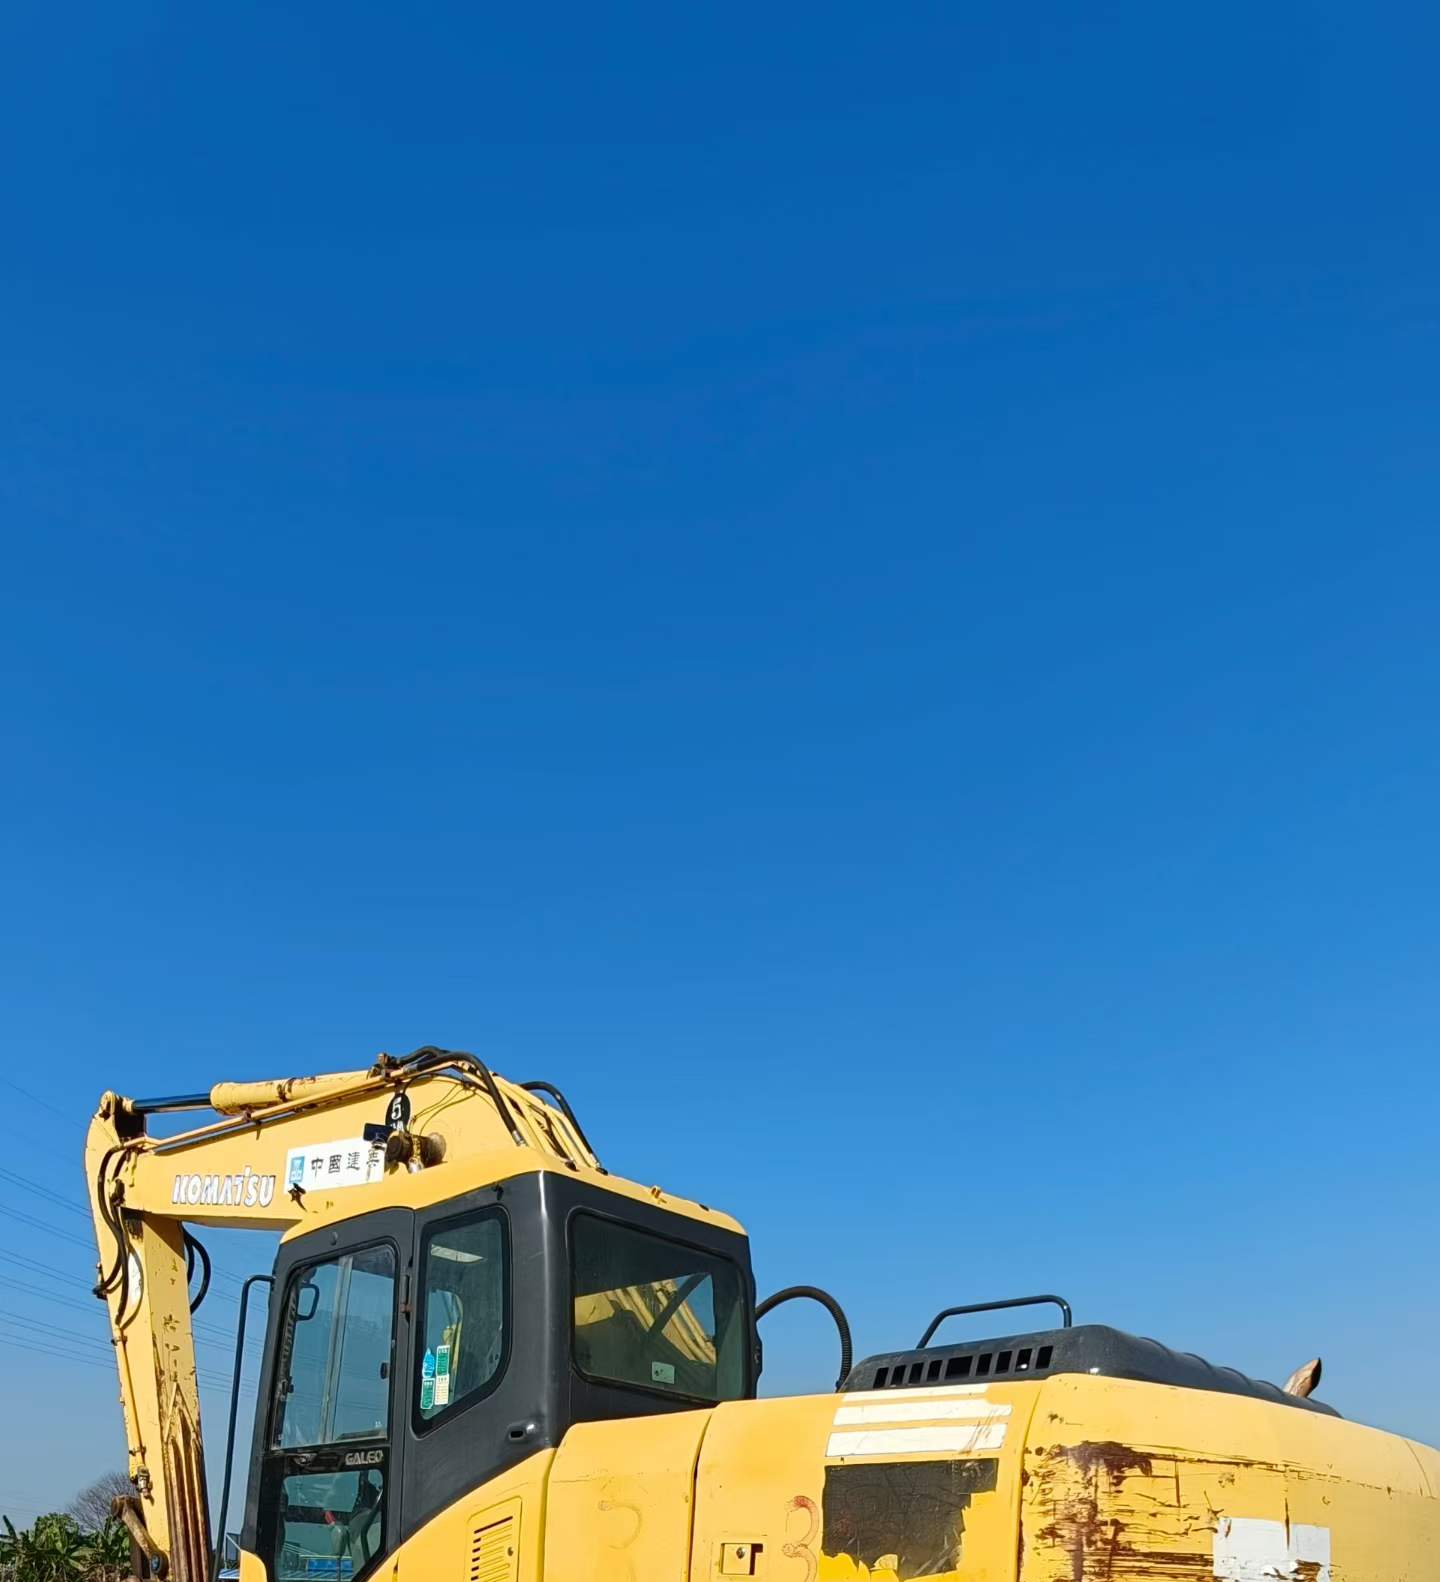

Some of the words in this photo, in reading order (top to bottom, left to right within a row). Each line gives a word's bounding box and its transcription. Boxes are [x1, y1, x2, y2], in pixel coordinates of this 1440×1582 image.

[391, 1096, 402, 1120] 5
[172, 1165, 276, 1208] KOMATSU
[345, 1450, 384, 1466] GALEO
